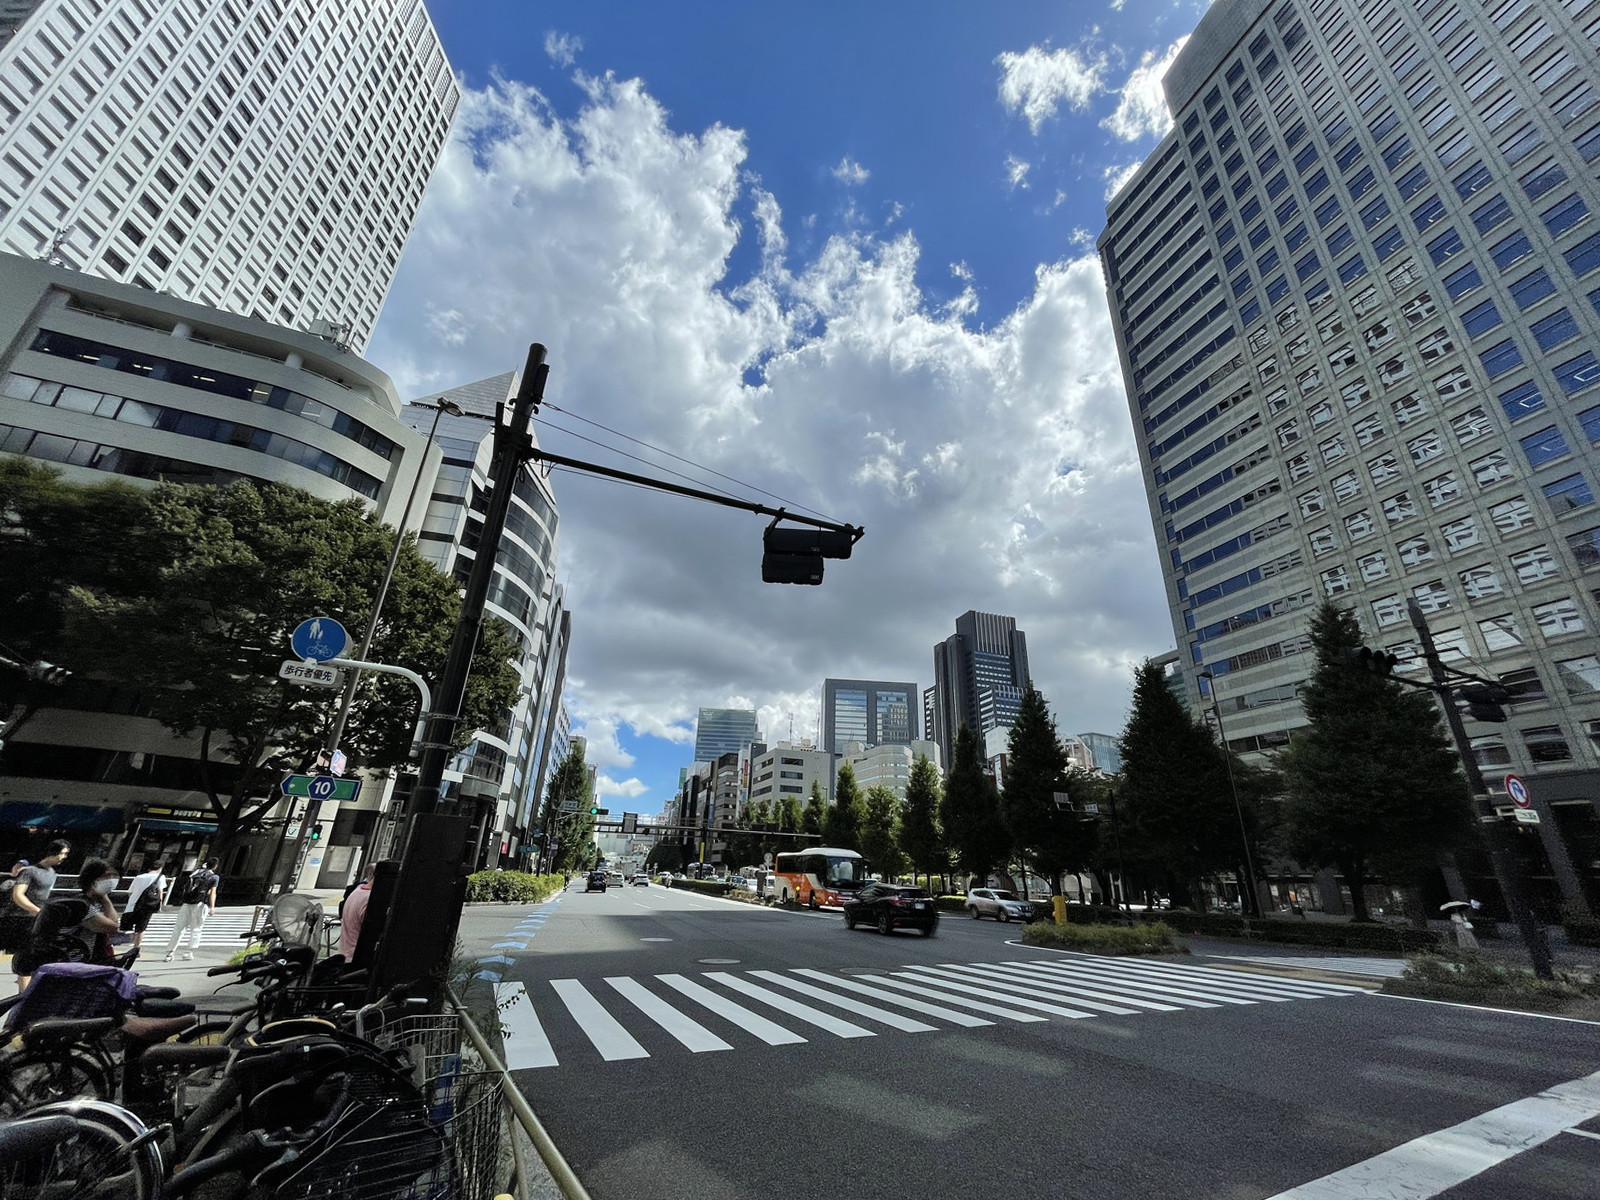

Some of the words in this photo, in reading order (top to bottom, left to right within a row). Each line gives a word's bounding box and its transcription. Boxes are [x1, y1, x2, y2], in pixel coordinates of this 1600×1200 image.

[284, 665, 332, 681] 歩行者優先
[314, 781, 331, 795] 10
